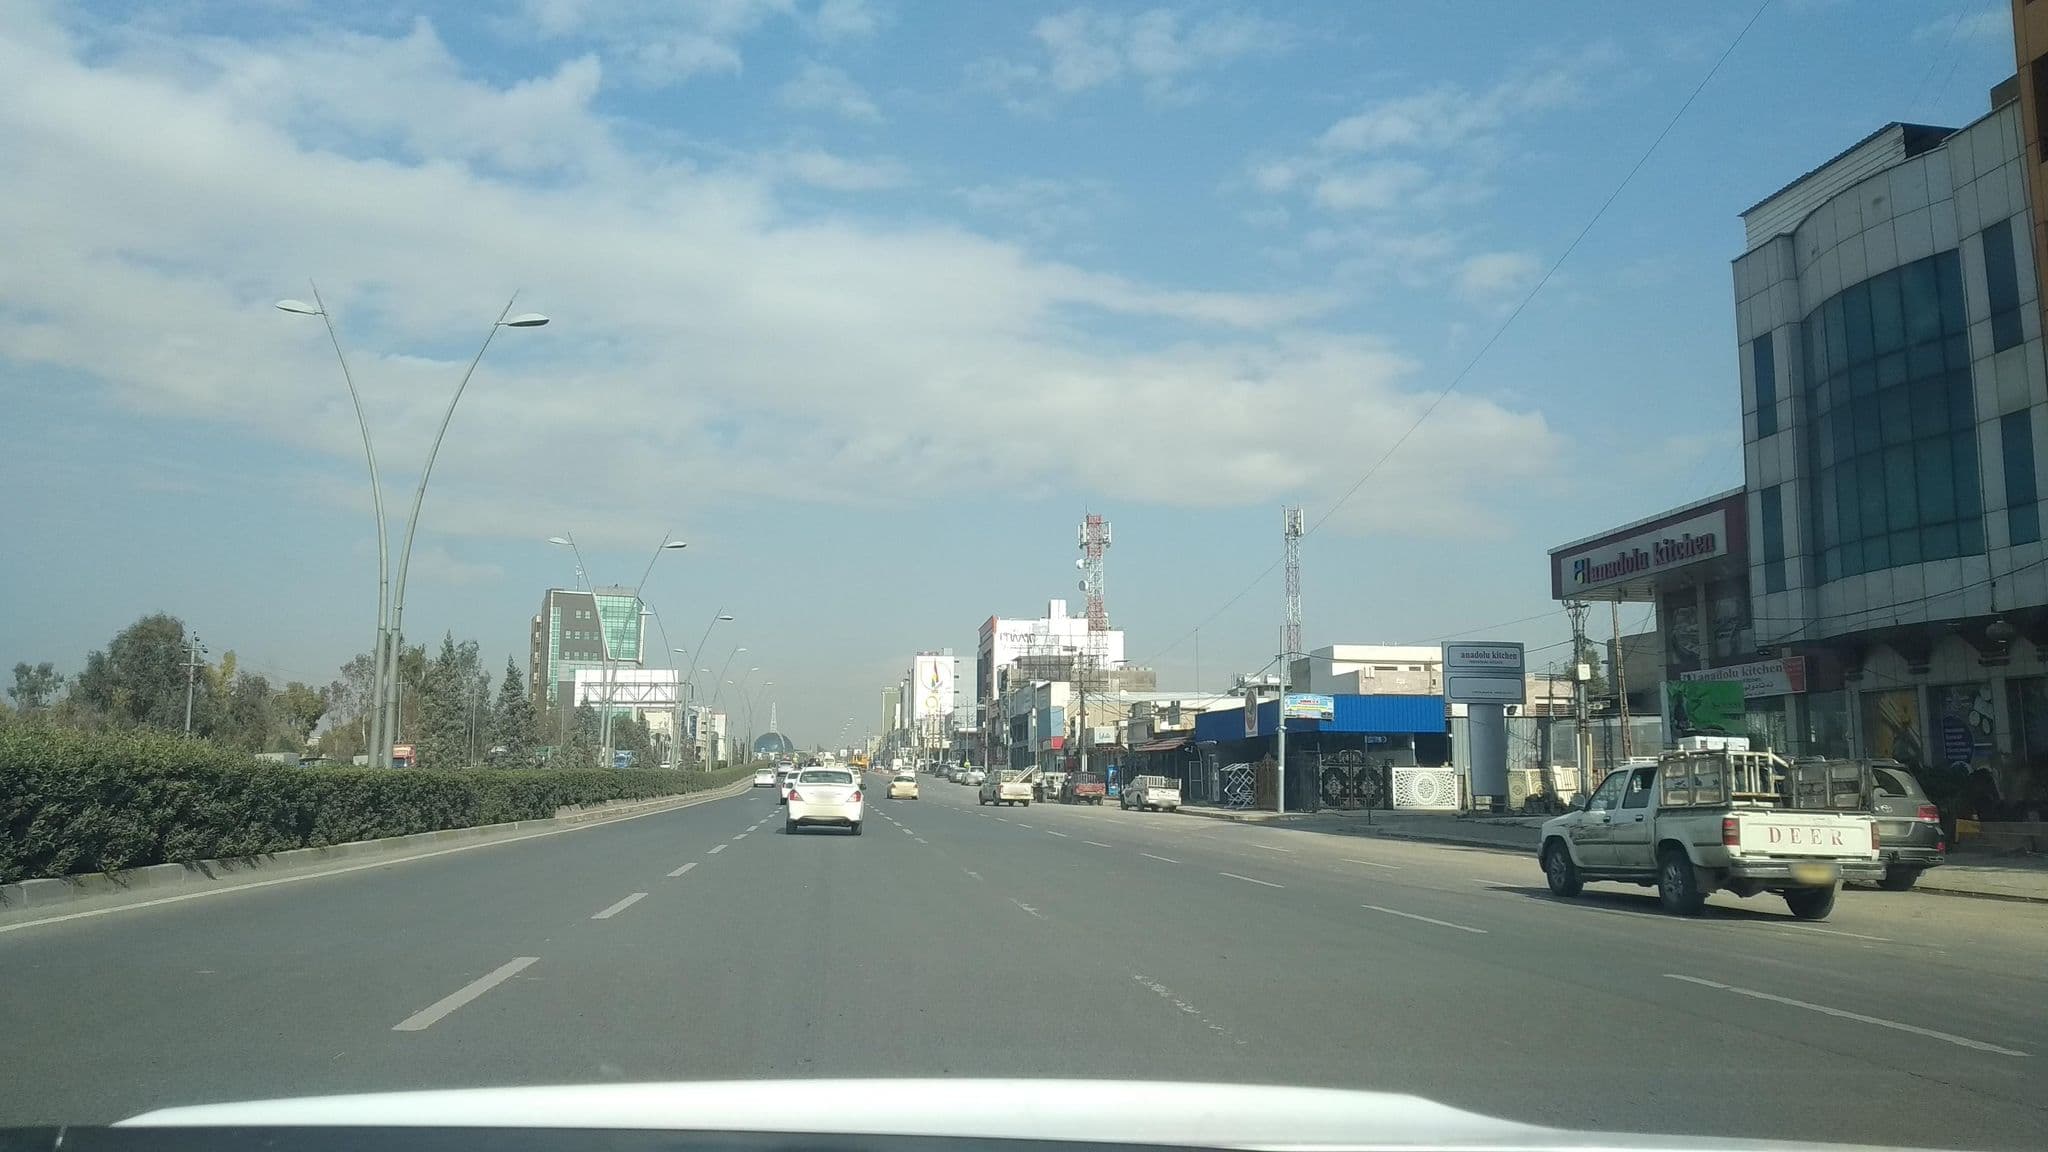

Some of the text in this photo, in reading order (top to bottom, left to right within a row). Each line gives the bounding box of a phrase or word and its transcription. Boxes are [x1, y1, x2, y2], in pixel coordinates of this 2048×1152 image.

[1591, 548, 1649, 582] anadolu
[1653, 533, 1716, 566] kitchen
[1461, 651, 1517, 660] anadolu kitchen
[1698, 669, 1739, 681] anadolu
[1741, 663, 1783, 678] kitchen
[1768, 827, 1843, 845] DEER
